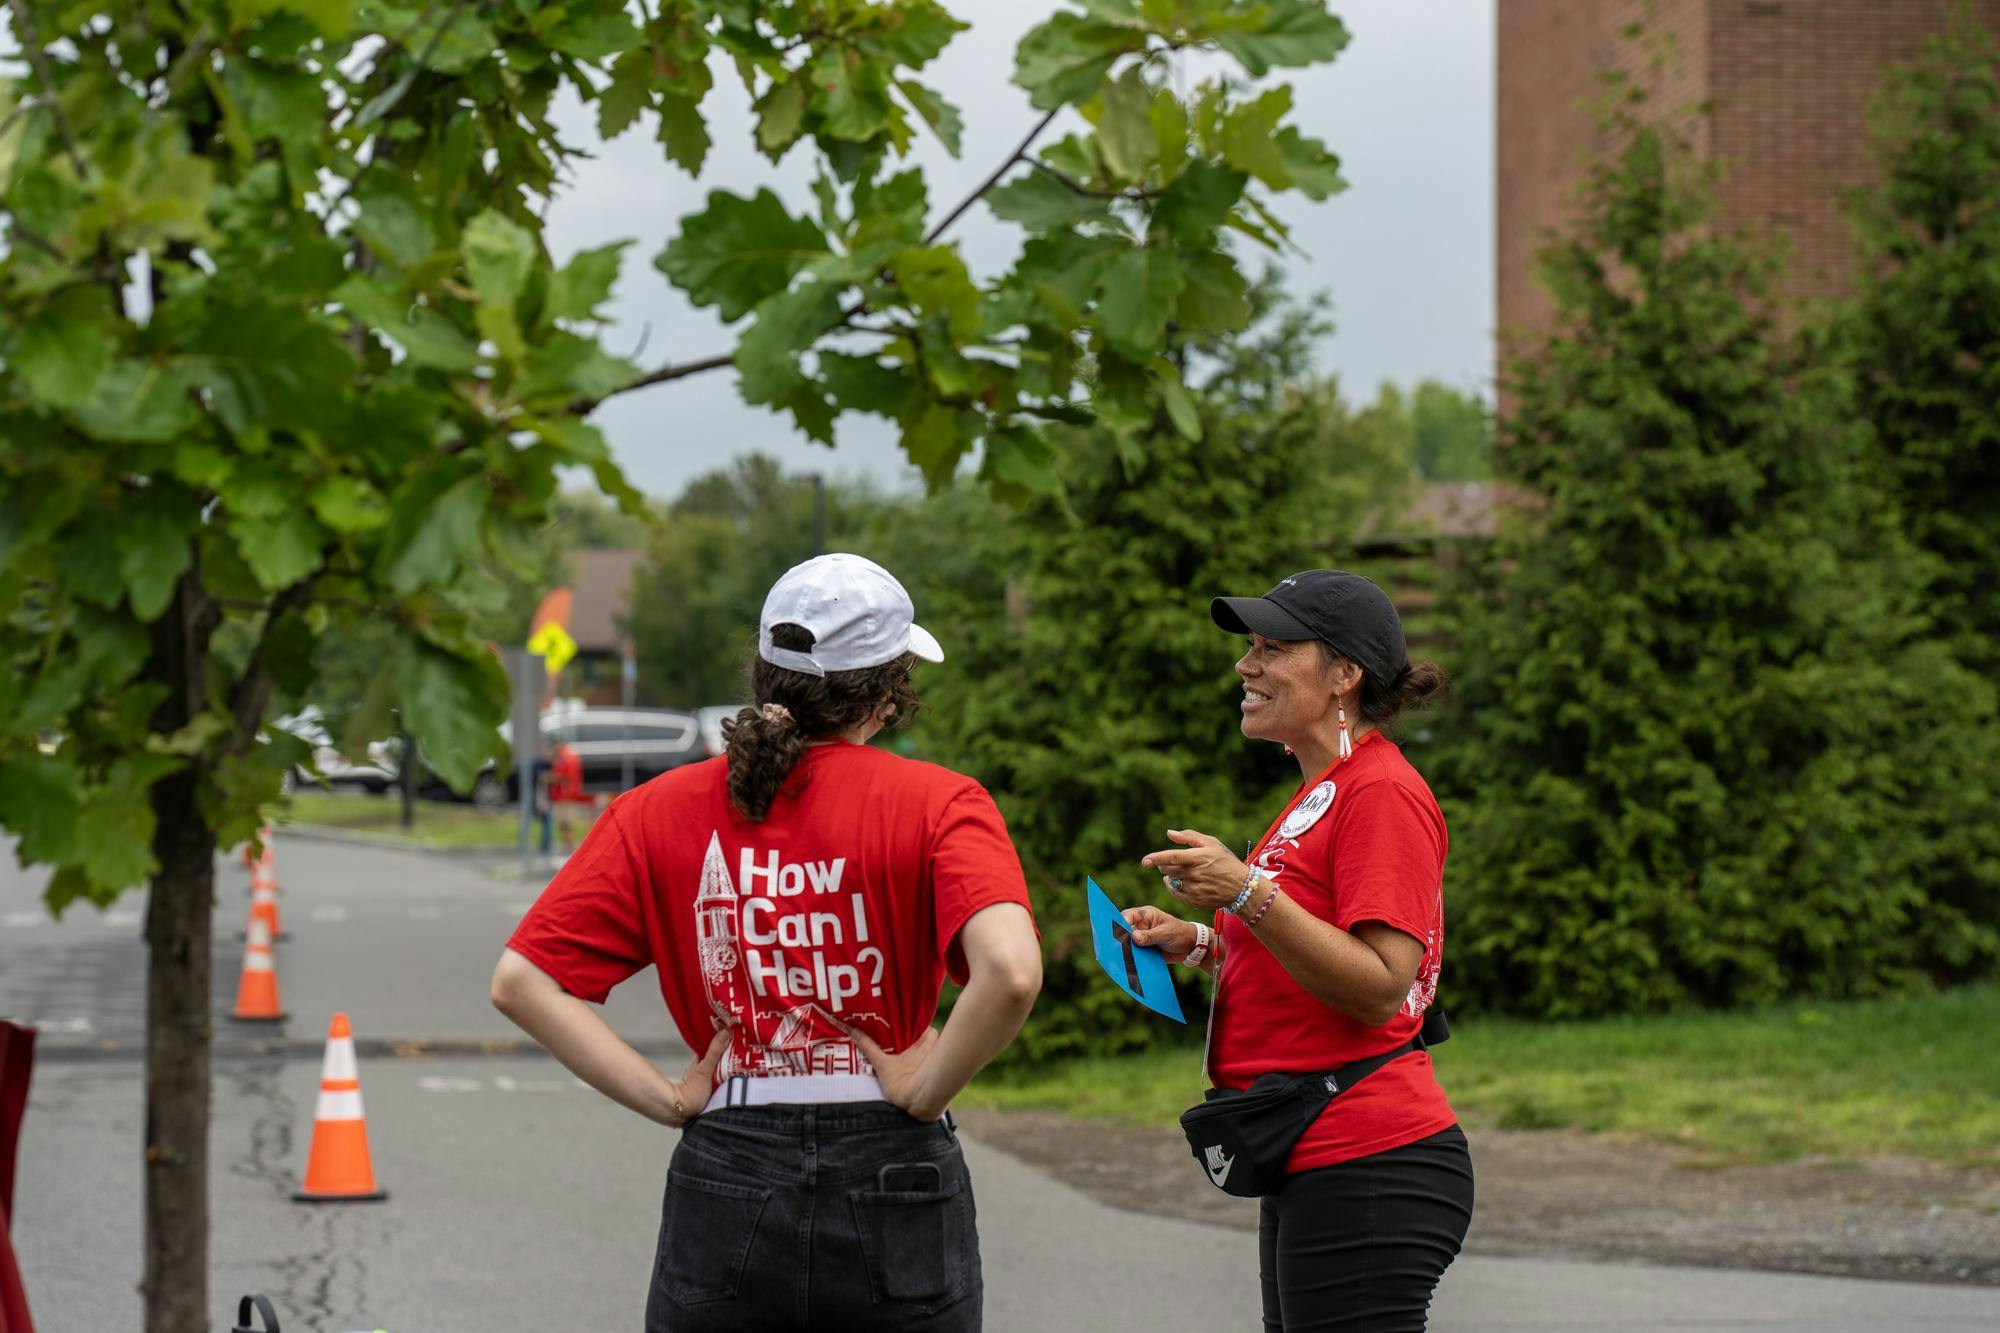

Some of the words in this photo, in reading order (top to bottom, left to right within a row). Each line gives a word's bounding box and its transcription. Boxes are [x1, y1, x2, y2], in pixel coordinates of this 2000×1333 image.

[739, 847, 846, 897] How
[742, 897, 843, 947] Can
[851, 893, 869, 942] I
[746, 947, 884, 1013] Help?
[1204, 1144, 1228, 1170] NIKE
